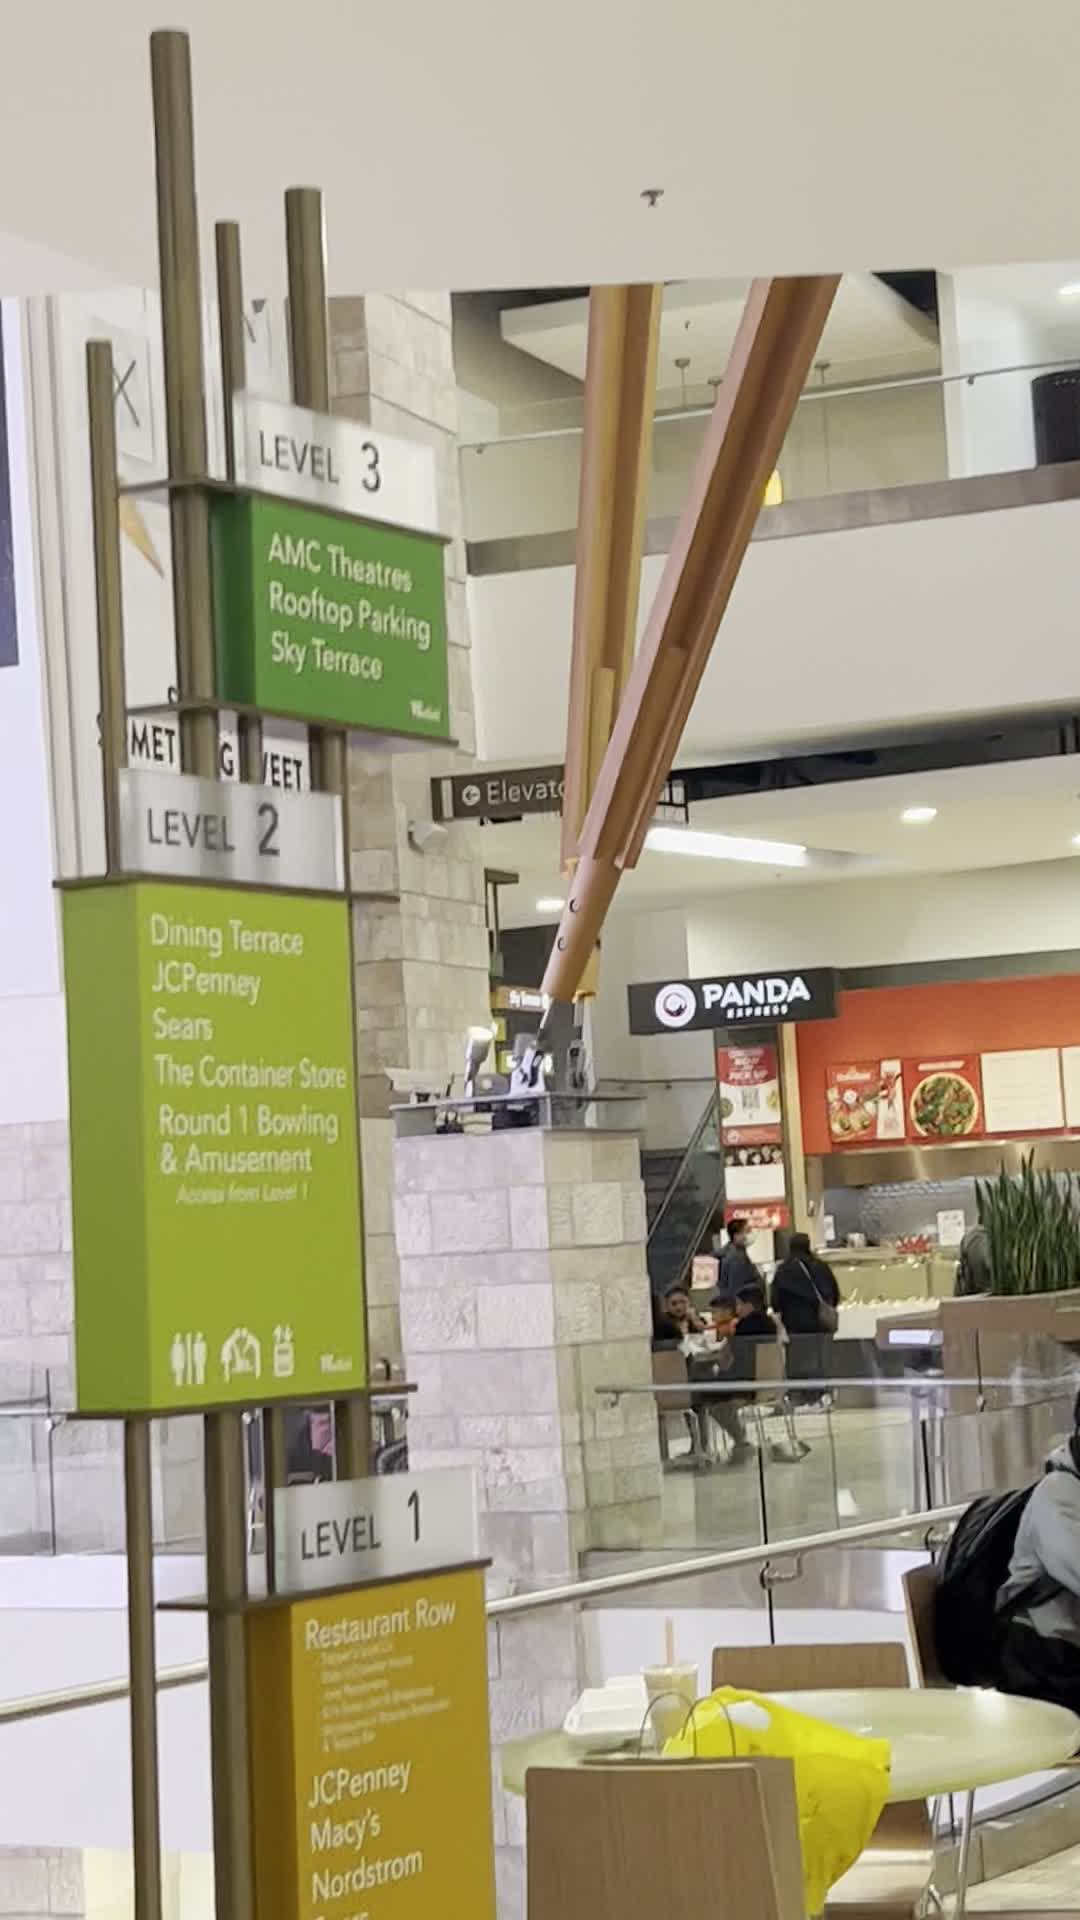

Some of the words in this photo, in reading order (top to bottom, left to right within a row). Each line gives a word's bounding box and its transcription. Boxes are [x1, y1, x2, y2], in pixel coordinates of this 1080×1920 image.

[259, 430, 339, 485] LEVEL
[361, 441, 381, 493] 3
[268, 531, 321, 574] AMC
[327, 544, 412, 593] Theatres
[269, 580, 353, 632] Rooftop
[359, 600, 431, 650] Parking
[271, 630, 307, 674] Sky
[311, 639, 383, 681] Terrace
[147, 807, 235, 852] LEVEL
[258, 802, 281, 857] 2
[150, 912, 223, 958] Dining
[229, 919, 304, 955] Terrace
[152, 960, 261, 1005] JCPenney
[702, 976, 811, 1009] PANDA
[153, 1007, 213, 1041] Sears
[726, 1004, 788, 1020] EXPRESS
[154, 1053, 194, 1087] The
[200, 1055, 294, 1089] Container
[300, 1056, 346, 1089] Store
[159, 1103, 231, 1136] Round
[239, 1104, 248, 1135] 1
[257, 1103, 338, 1144] Bowling
[160, 1142, 177, 1175] &
[185, 1143, 312, 1173] Amusement
[302, 1514, 381, 1560] LEVEL
[407, 1489, 420, 1543] 1
[304, 1608, 411, 1650] Restaurant
[415, 1597, 456, 1630] Row
[308, 1759, 412, 1808] JCPenney
[310, 1807, 381, 1854] Macy's
[312, 1850, 424, 1904] Nordstrom
